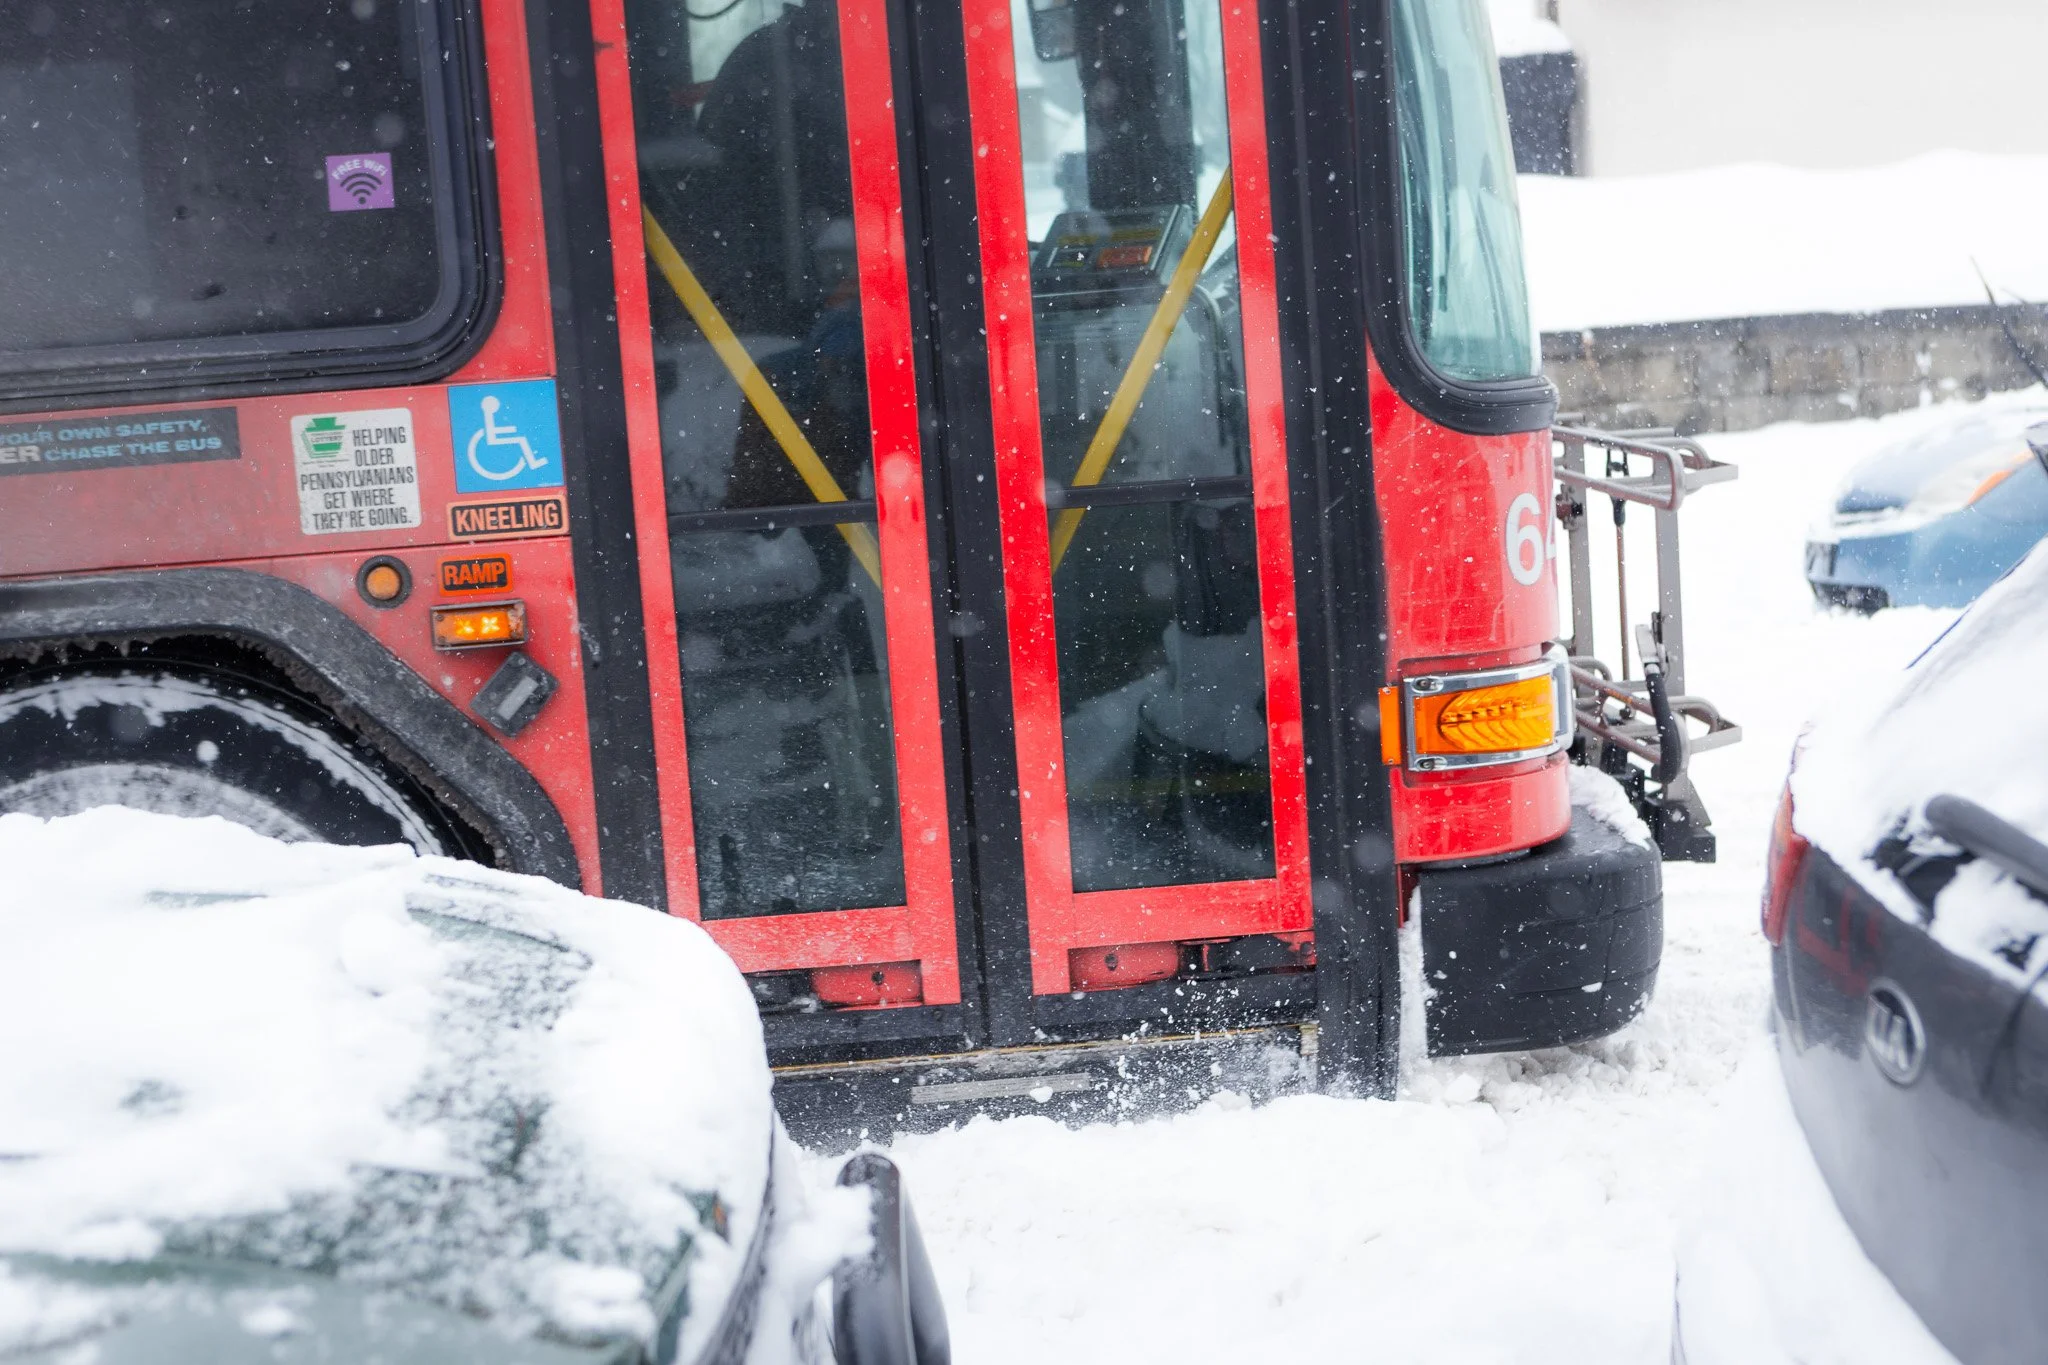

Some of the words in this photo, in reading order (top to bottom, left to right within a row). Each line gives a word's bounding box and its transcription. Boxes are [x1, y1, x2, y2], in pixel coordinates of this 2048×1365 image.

[331, 159, 361, 180] FREE
[58, 426, 111, 441] OWN
[115, 419, 207, 437] SAFETY,
[352, 426, 406, 447] HELPING
[44, 444, 122, 462] CHASE
[126, 441, 170, 455] THE
[175, 437, 222, 452] BUS
[354, 447, 394, 467] OLDER
[300, 466, 414, 491] PENNSYLVANIANS
[323, 492, 346, 509] GET
[351, 488, 395, 507] WHERE
[312, 510, 365, 530] THEY'RE
[369, 507, 412, 526] GOING.
[455, 502, 559, 533] KNEELING
[444, 561, 505, 586] RAMP
